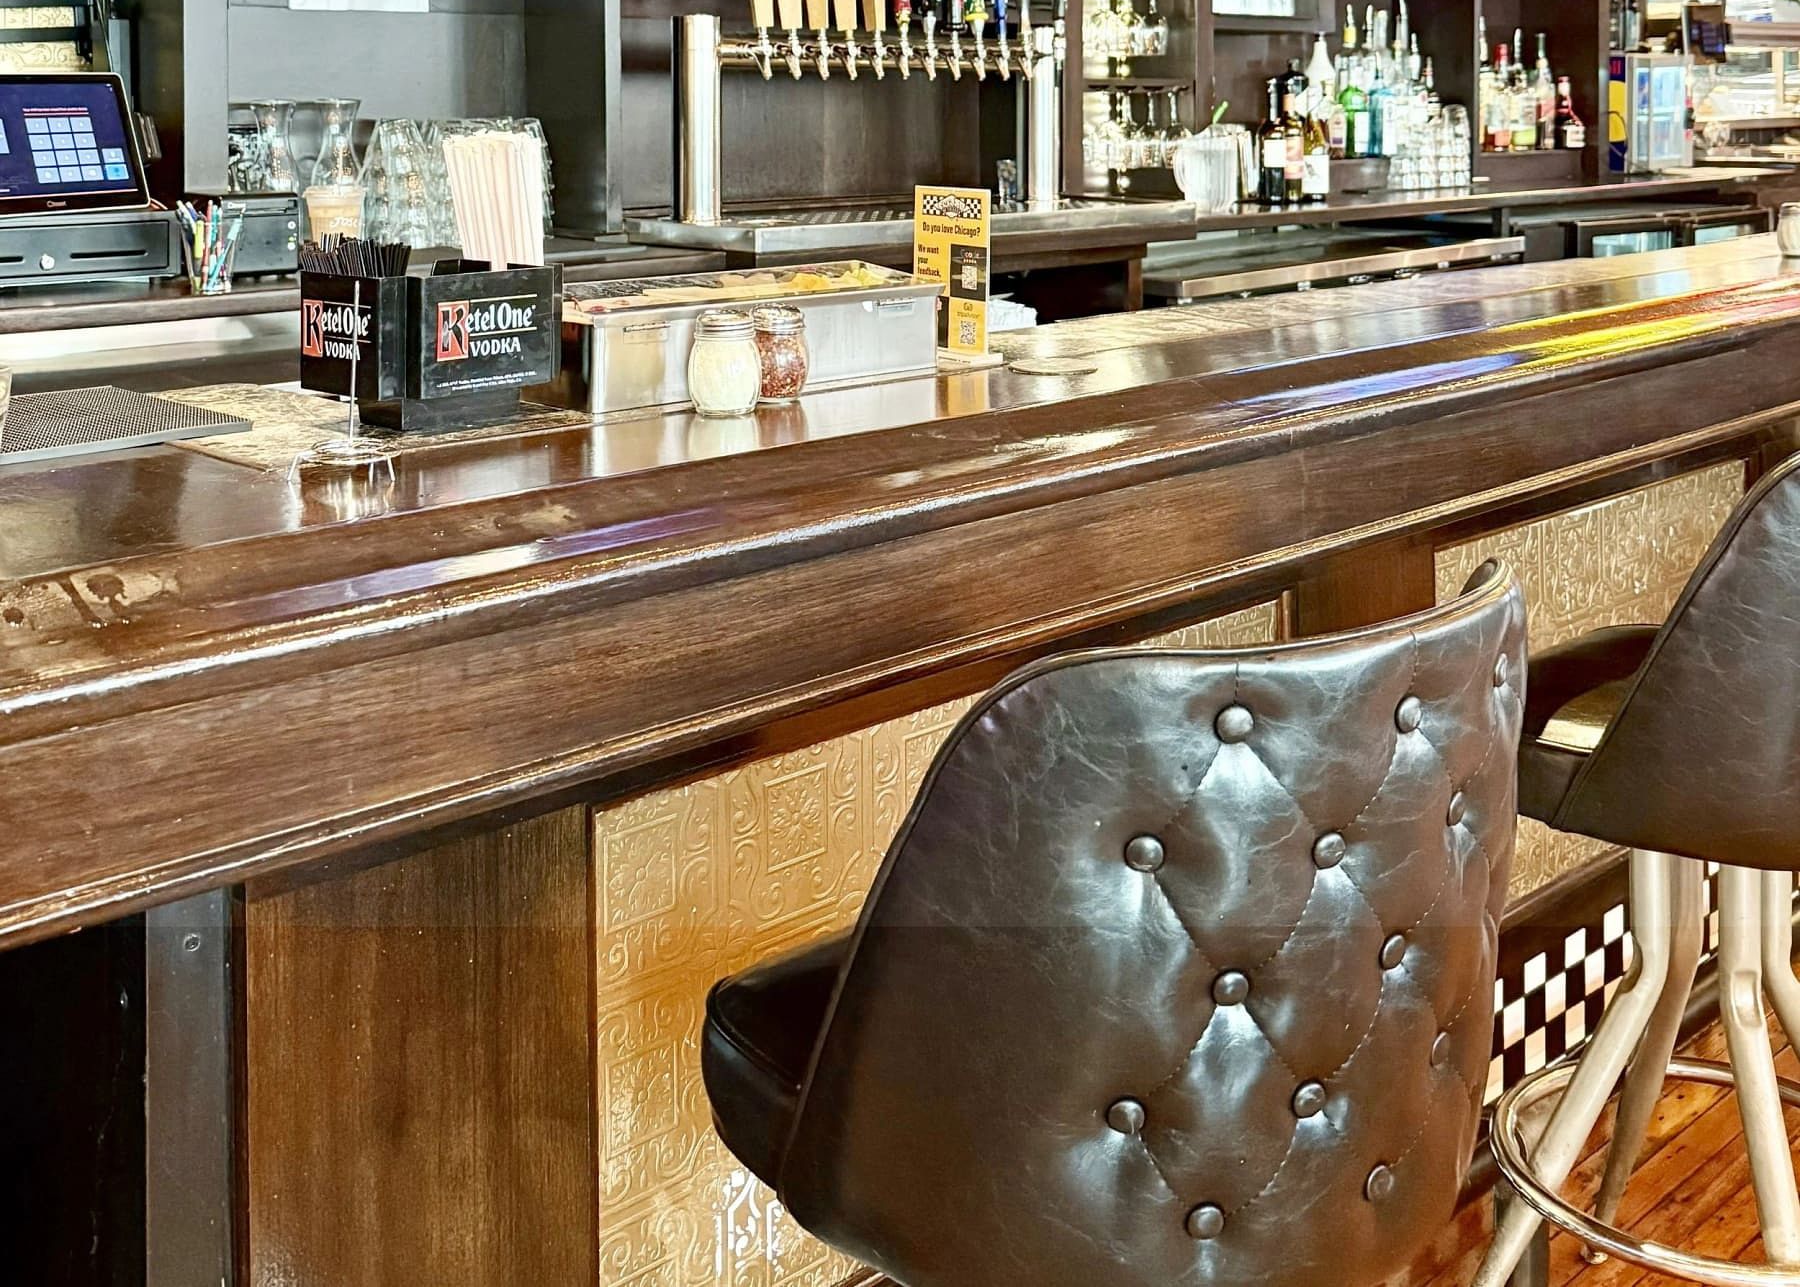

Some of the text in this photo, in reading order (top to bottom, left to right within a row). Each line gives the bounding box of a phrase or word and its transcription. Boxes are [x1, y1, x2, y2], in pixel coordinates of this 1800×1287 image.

[922, 221, 981, 239] Do you love Chicago?
[303, 302, 370, 355] Ketel One
[439, 302, 532, 355] Ketel One
[325, 341, 360, 360] VODKA
[470, 337, 521, 357] VODKA
